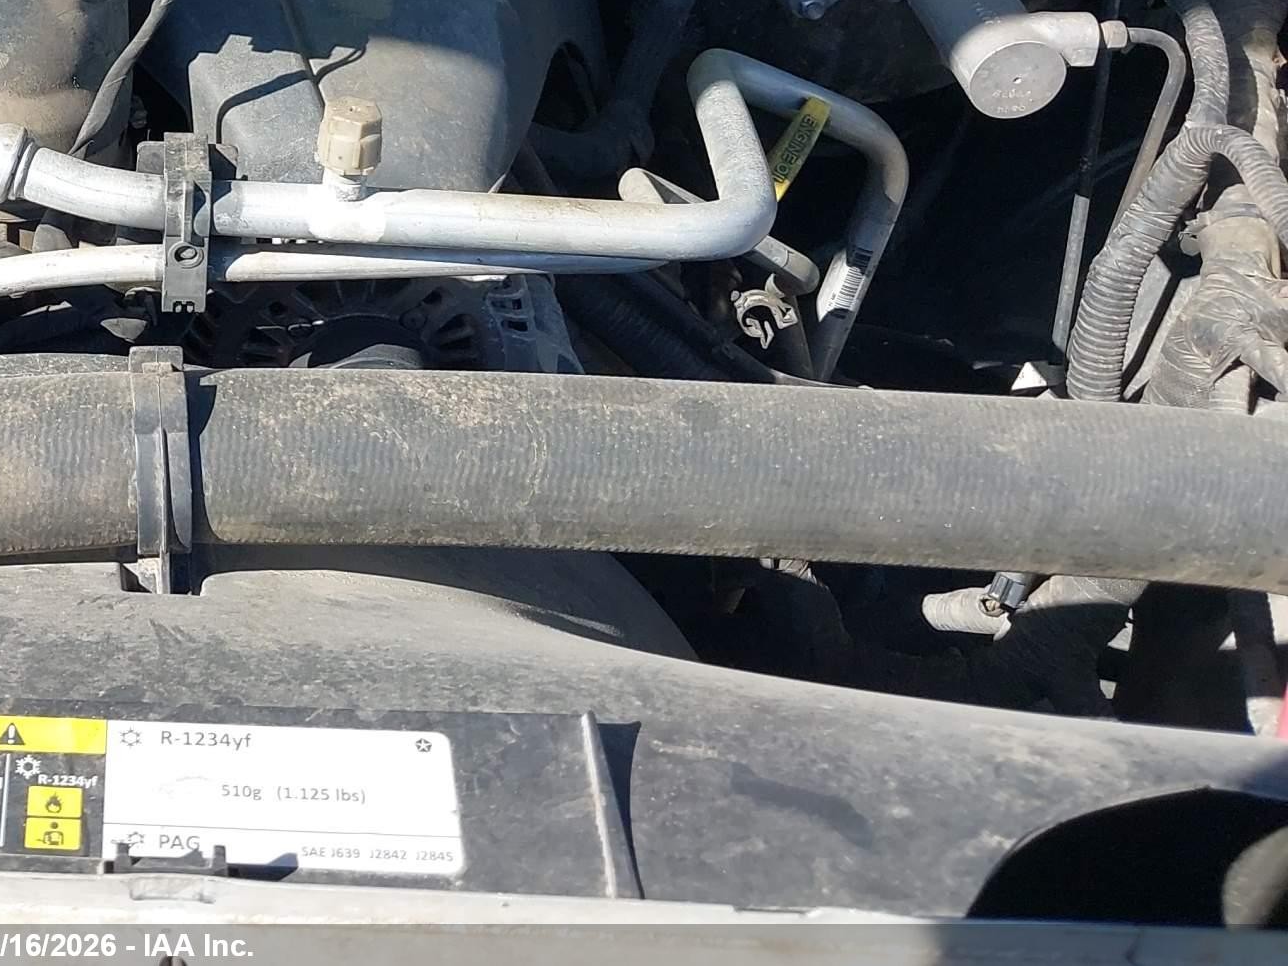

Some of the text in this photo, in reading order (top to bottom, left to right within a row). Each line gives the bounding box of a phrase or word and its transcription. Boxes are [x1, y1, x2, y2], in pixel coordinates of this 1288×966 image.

[784, 114, 817, 165] ENGINE
[161, 731, 252, 751] R-1234yf
[38, 774, 98, 789] R-1234yf
[221, 784, 367, 804] 510g (1.125 lbs)
[159, 834, 201, 851] PAG
[301, 846, 454, 862] SAE J639 J2842 J2845
